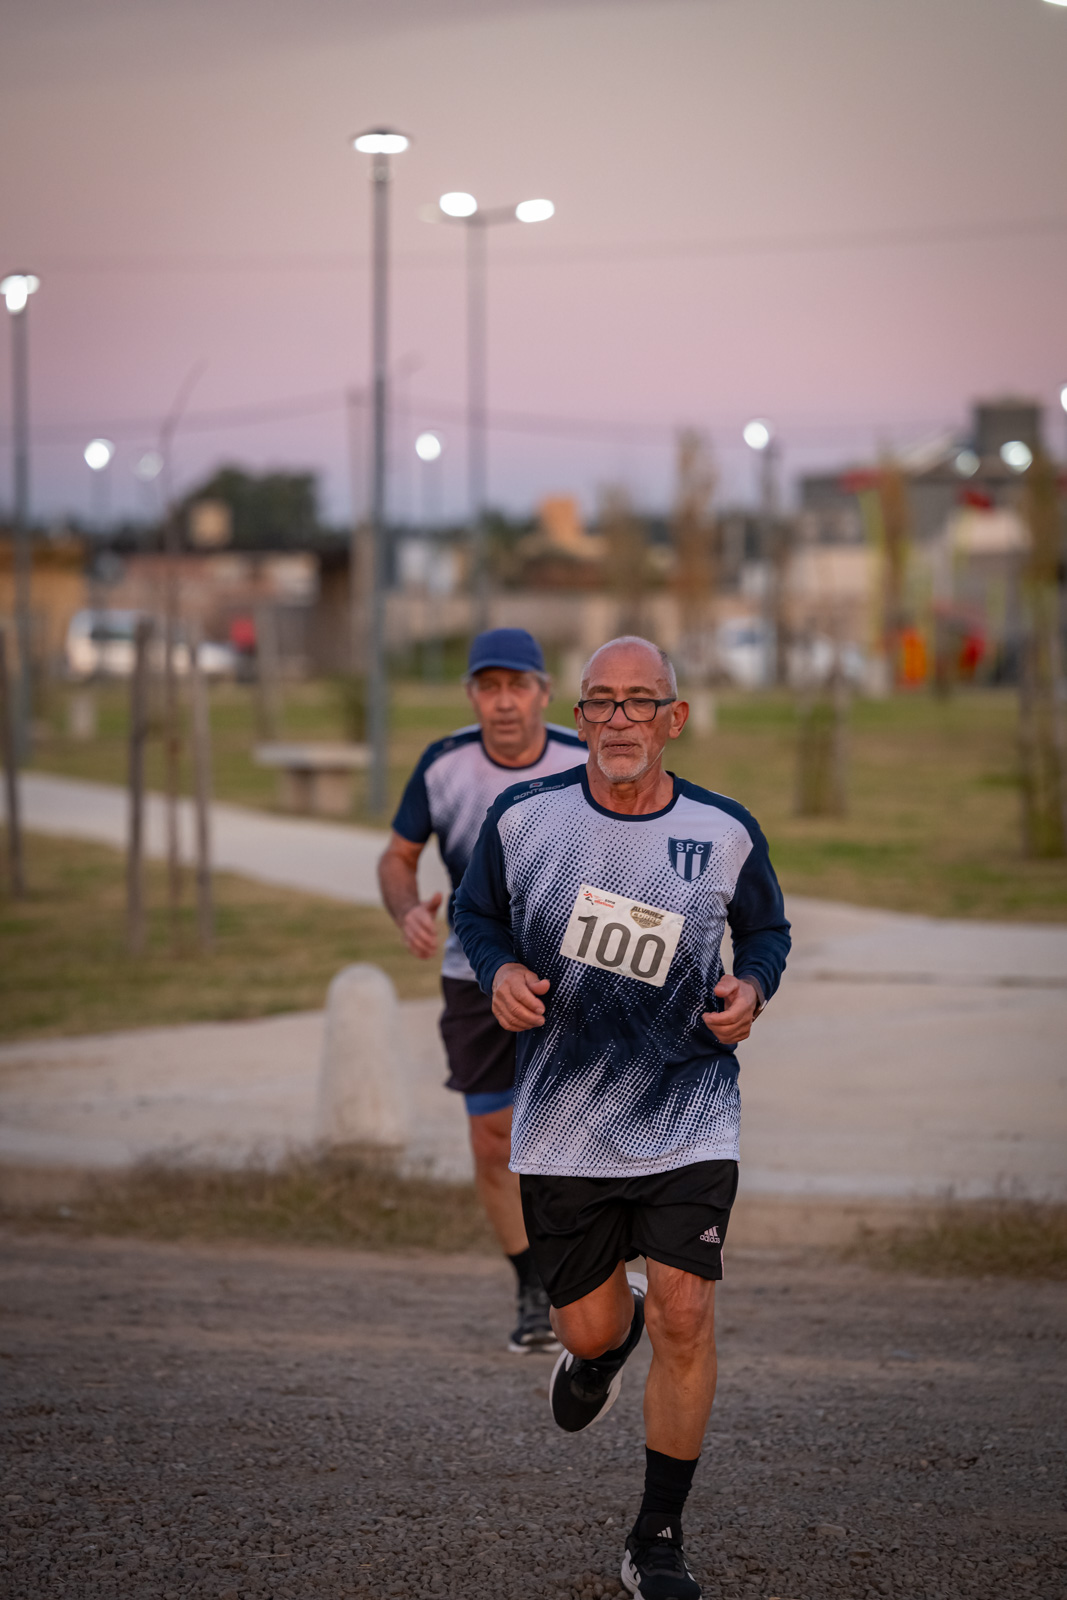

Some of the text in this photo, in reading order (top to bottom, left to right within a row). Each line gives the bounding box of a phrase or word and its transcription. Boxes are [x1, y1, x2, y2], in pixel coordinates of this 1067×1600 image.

[675, 842, 705, 854] SFC
[631, 906, 664, 919] ALVAREZ
[631, 911, 661, 924] CORRE
[577, 915, 666, 978] 100
[699, 1234, 721, 1244] adidas
